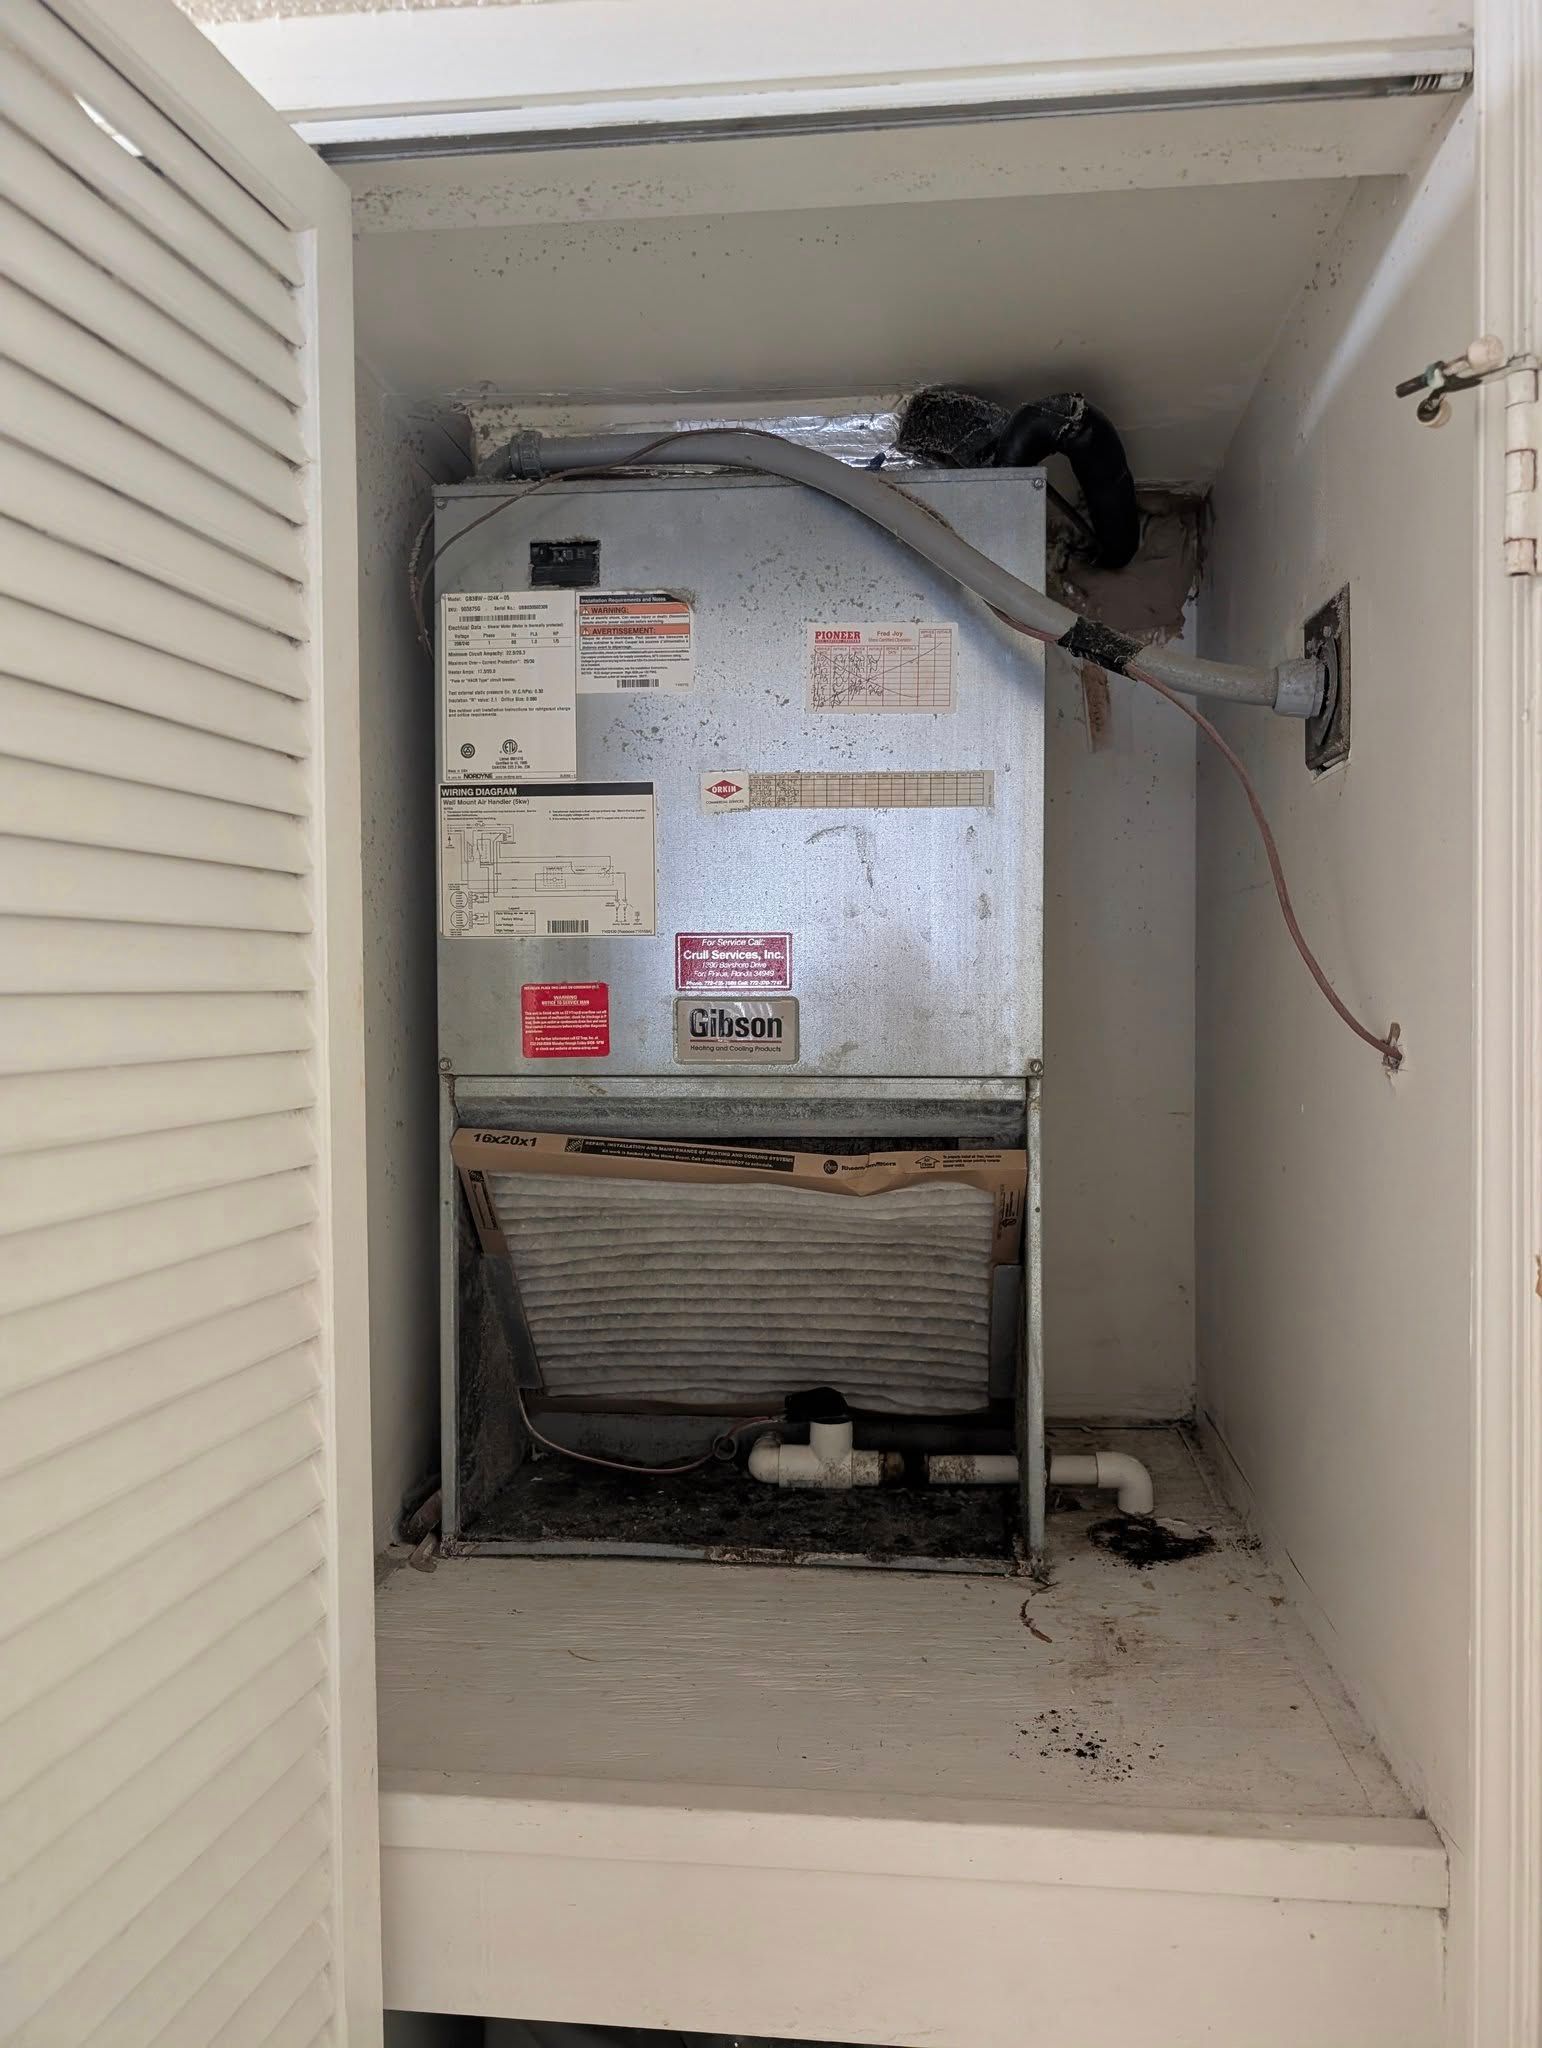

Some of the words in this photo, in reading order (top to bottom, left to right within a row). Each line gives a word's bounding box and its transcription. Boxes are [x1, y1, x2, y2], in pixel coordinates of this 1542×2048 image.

[592, 627, 656, 635] AVERTISSEMENT:
[815, 631, 861, 639] PIONEER
[441, 788, 473, 796] WIRING
[711, 785, 736, 794] ORKIN
[683, 950, 709, 959] Crull
[711, 950, 761, 960] Services,
[764, 950, 784, 959] Inc.
[690, 1009, 782, 1038] Gibson
[473, 1134, 538, 1147] 16x20x1
